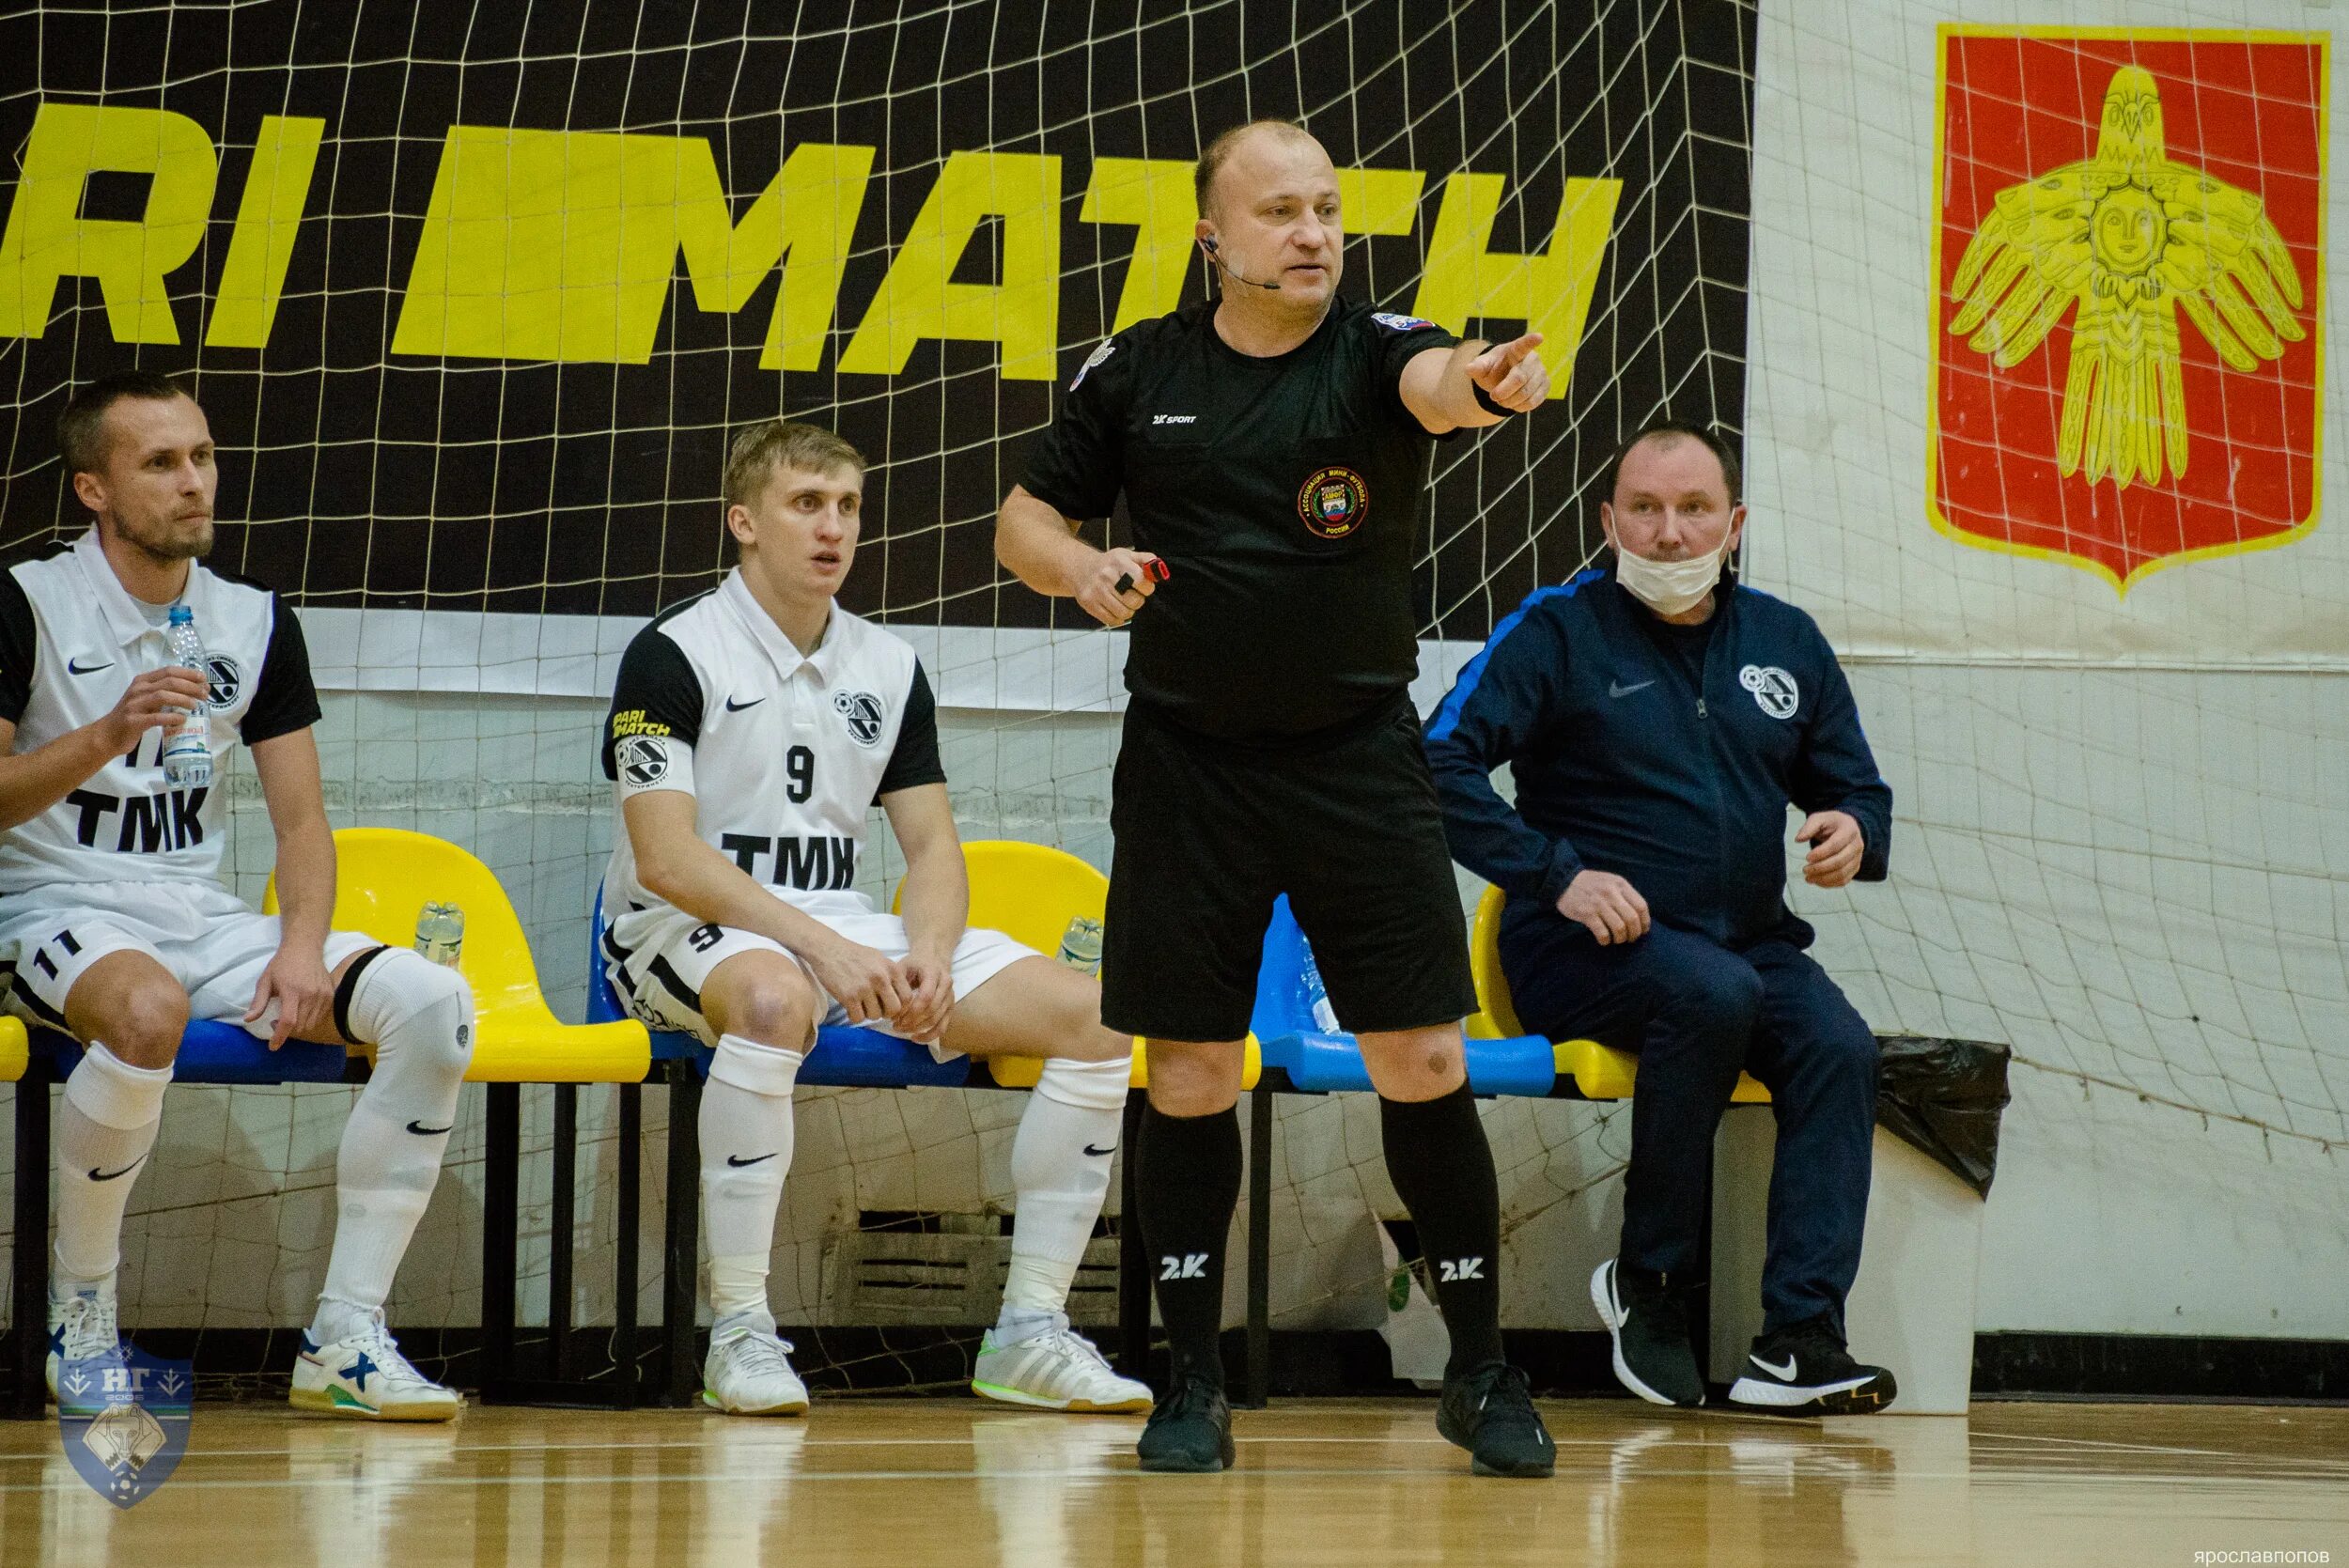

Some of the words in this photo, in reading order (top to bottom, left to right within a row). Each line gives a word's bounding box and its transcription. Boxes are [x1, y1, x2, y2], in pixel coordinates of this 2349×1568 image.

[0, 102, 327, 349] RI
[391, 125, 1624, 400] MATH
[1152, 414, 1168, 425] 2K
[1166, 415, 1197, 424] SPORT
[1302, 473, 1326, 513] АССОЦИАЦИЯ
[1325, 523, 1350, 535] РОССИИ
[613, 709, 646, 729] PARI
[613, 722, 671, 739] MATCH
[786, 745, 815, 804] 9
[688, 923, 725, 954] 9
[33, 928, 83, 982] 11
[1159, 1254, 1209, 1281] 2K
[1439, 1257, 1485, 1282] 2K
